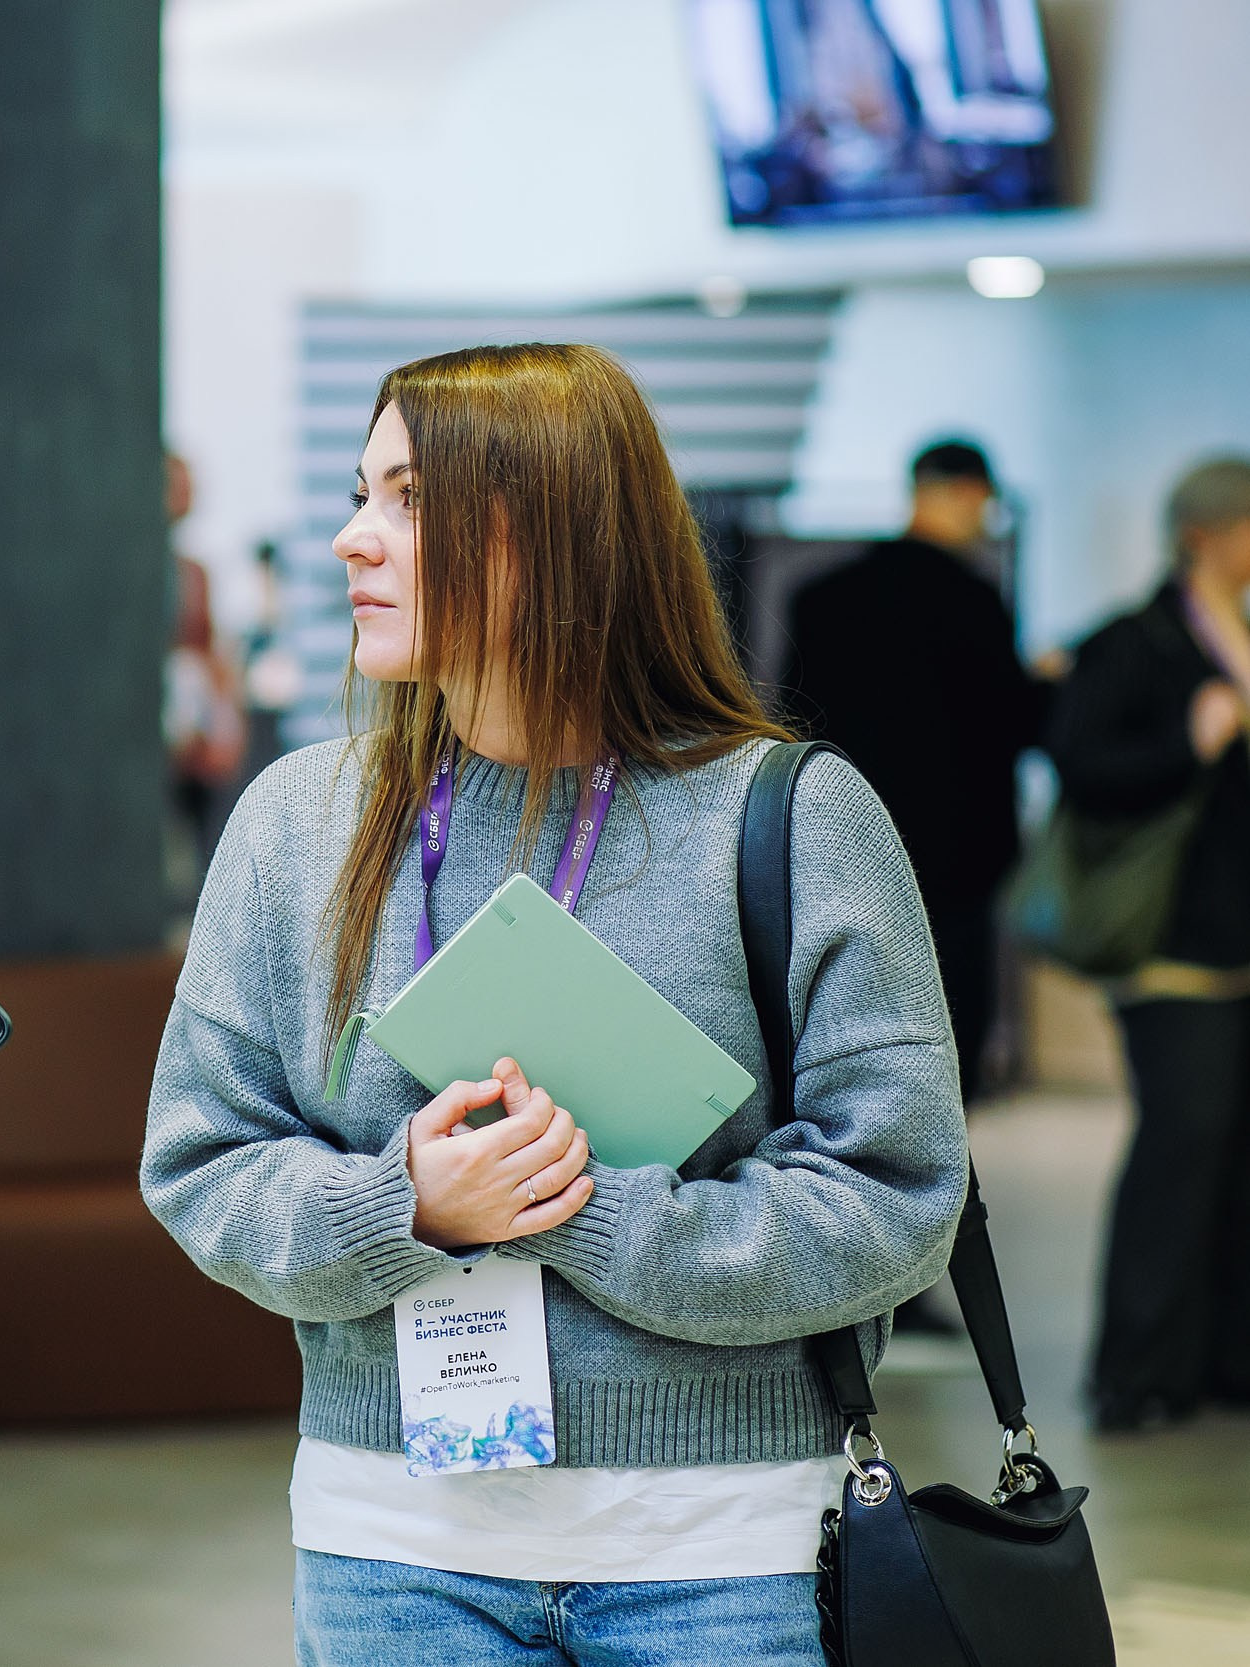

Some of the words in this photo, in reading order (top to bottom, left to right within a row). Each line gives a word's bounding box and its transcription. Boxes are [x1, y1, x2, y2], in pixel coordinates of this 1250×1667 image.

[590, 764, 604, 790] ФЕСТ
[571, 833, 587, 860] СБЕР
[427, 1298, 455, 1309] СБЕР
[414, 1318, 423, 1328] Я
[439, 1309, 507, 1326] УЧАСТНИК
[415, 1325, 464, 1340] БИЗНЕС
[467, 1322, 507, 1335] ФЕСТА
[447, 1350, 487, 1364] ЕЛЕНА
[440, 1362, 498, 1379] ВЕЛИЧКО
[420, 1374, 520, 1394] #OpenToWork_marketing
